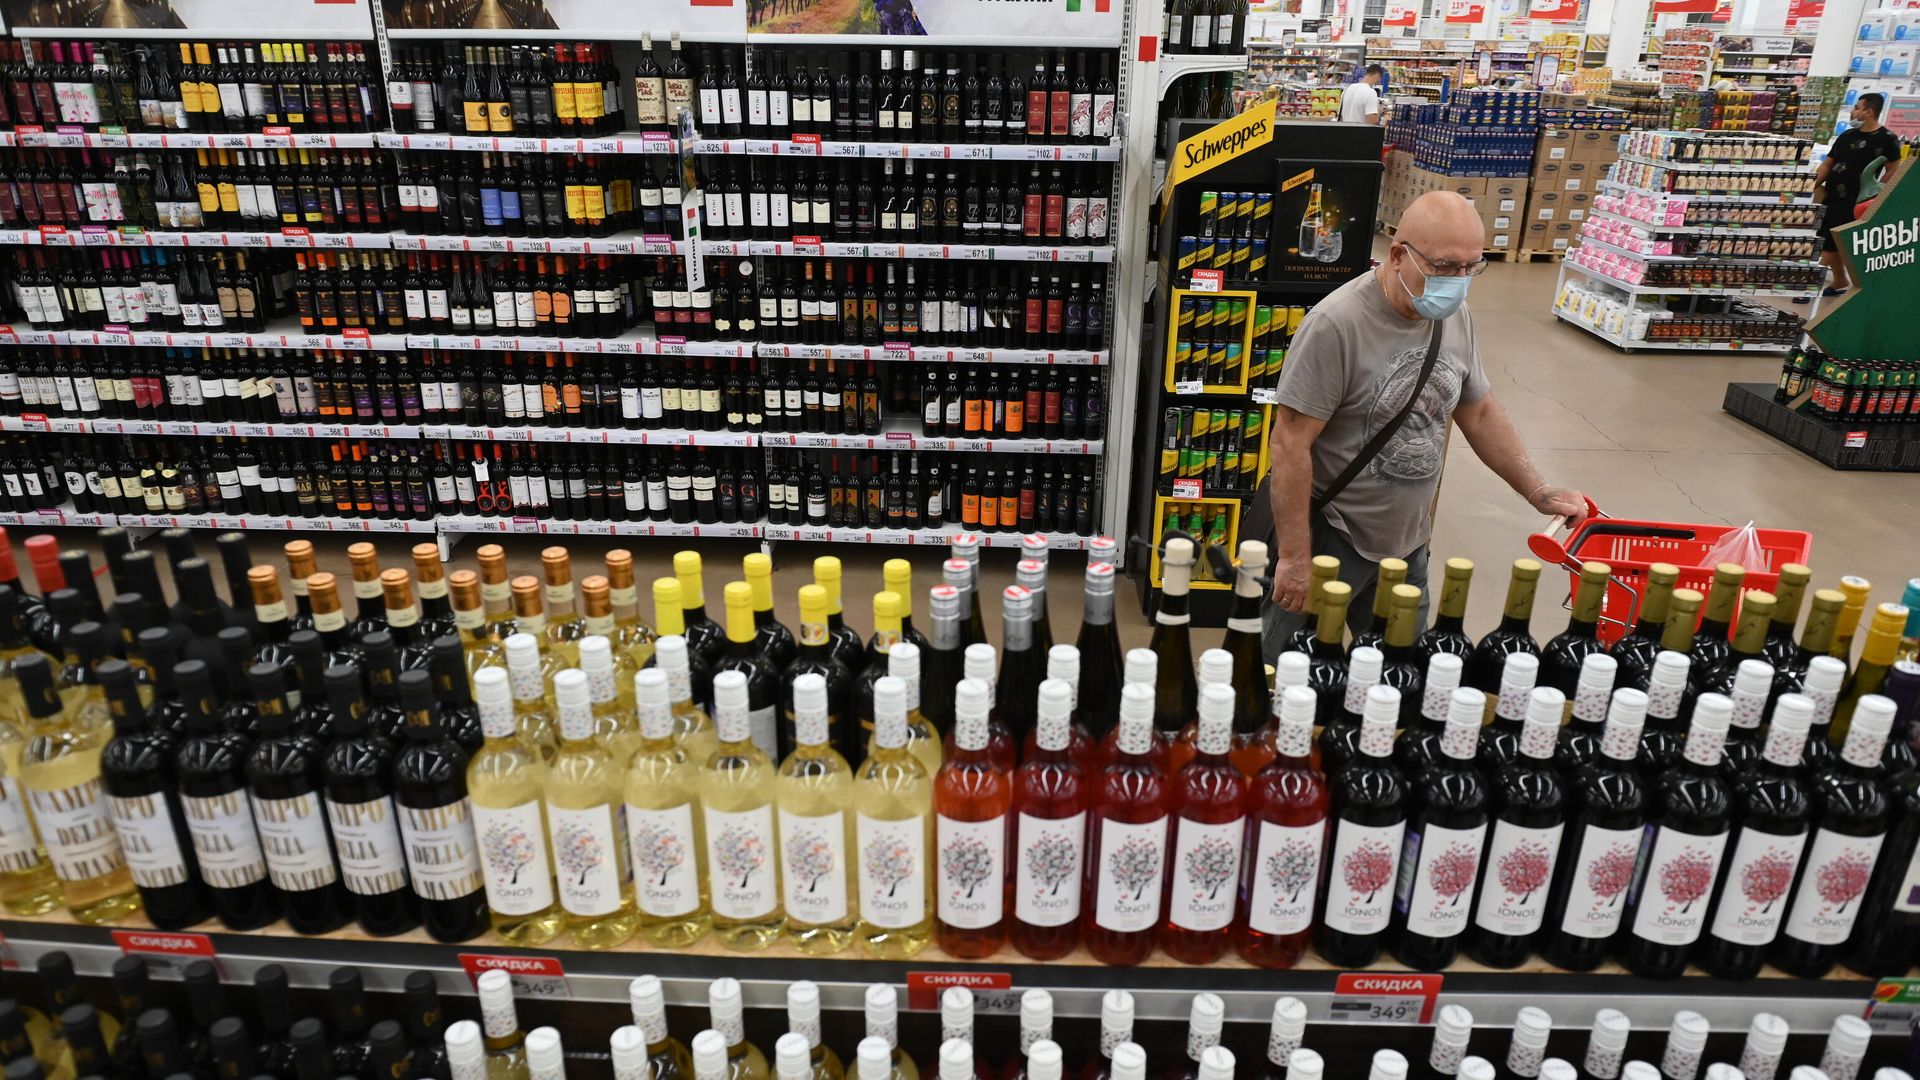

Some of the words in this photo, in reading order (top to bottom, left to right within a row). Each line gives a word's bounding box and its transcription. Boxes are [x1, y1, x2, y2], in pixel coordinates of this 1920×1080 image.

[1185, 119, 1266, 168] Schweppes
[1853, 218, 1919, 255] НОВЫ
[1865, 248, 1914, 273] ЛОУСОН
[496, 886, 534, 898] IONOS
[564, 886, 601, 898] IONOS
[644, 889, 680, 900] IONOS
[724, 890, 761, 901] IONOS
[793, 895, 830, 906] IONOS
[871, 899, 909, 911] IONOS
[949, 900, 986, 912] IONOS
[1032, 898, 1068, 910] IONOS
[1114, 903, 1151, 915] IONOS
[1188, 903, 1226, 915] IONOS
[1270, 906, 1306, 918] IONOS
[1344, 906, 1382, 917] IONOS
[1430, 908, 1464, 919] IONOS
[1498, 907, 1536, 918] IONOS
[1657, 916, 1696, 926] IONOS
[1737, 916, 1776, 927] IONOS
[1812, 916, 1851, 927] IONOS
[129, 936, 198, 950] СКИДКА
[476, 958, 545, 971] СКИДКА
[924, 976, 993, 985] СКИДКА
[1354, 980, 1423, 992] СКИДКА
[522, 983, 554, 994] 349
[980, 998, 1014, 1010] 349
[1370, 1006, 1406, 1019] 349
